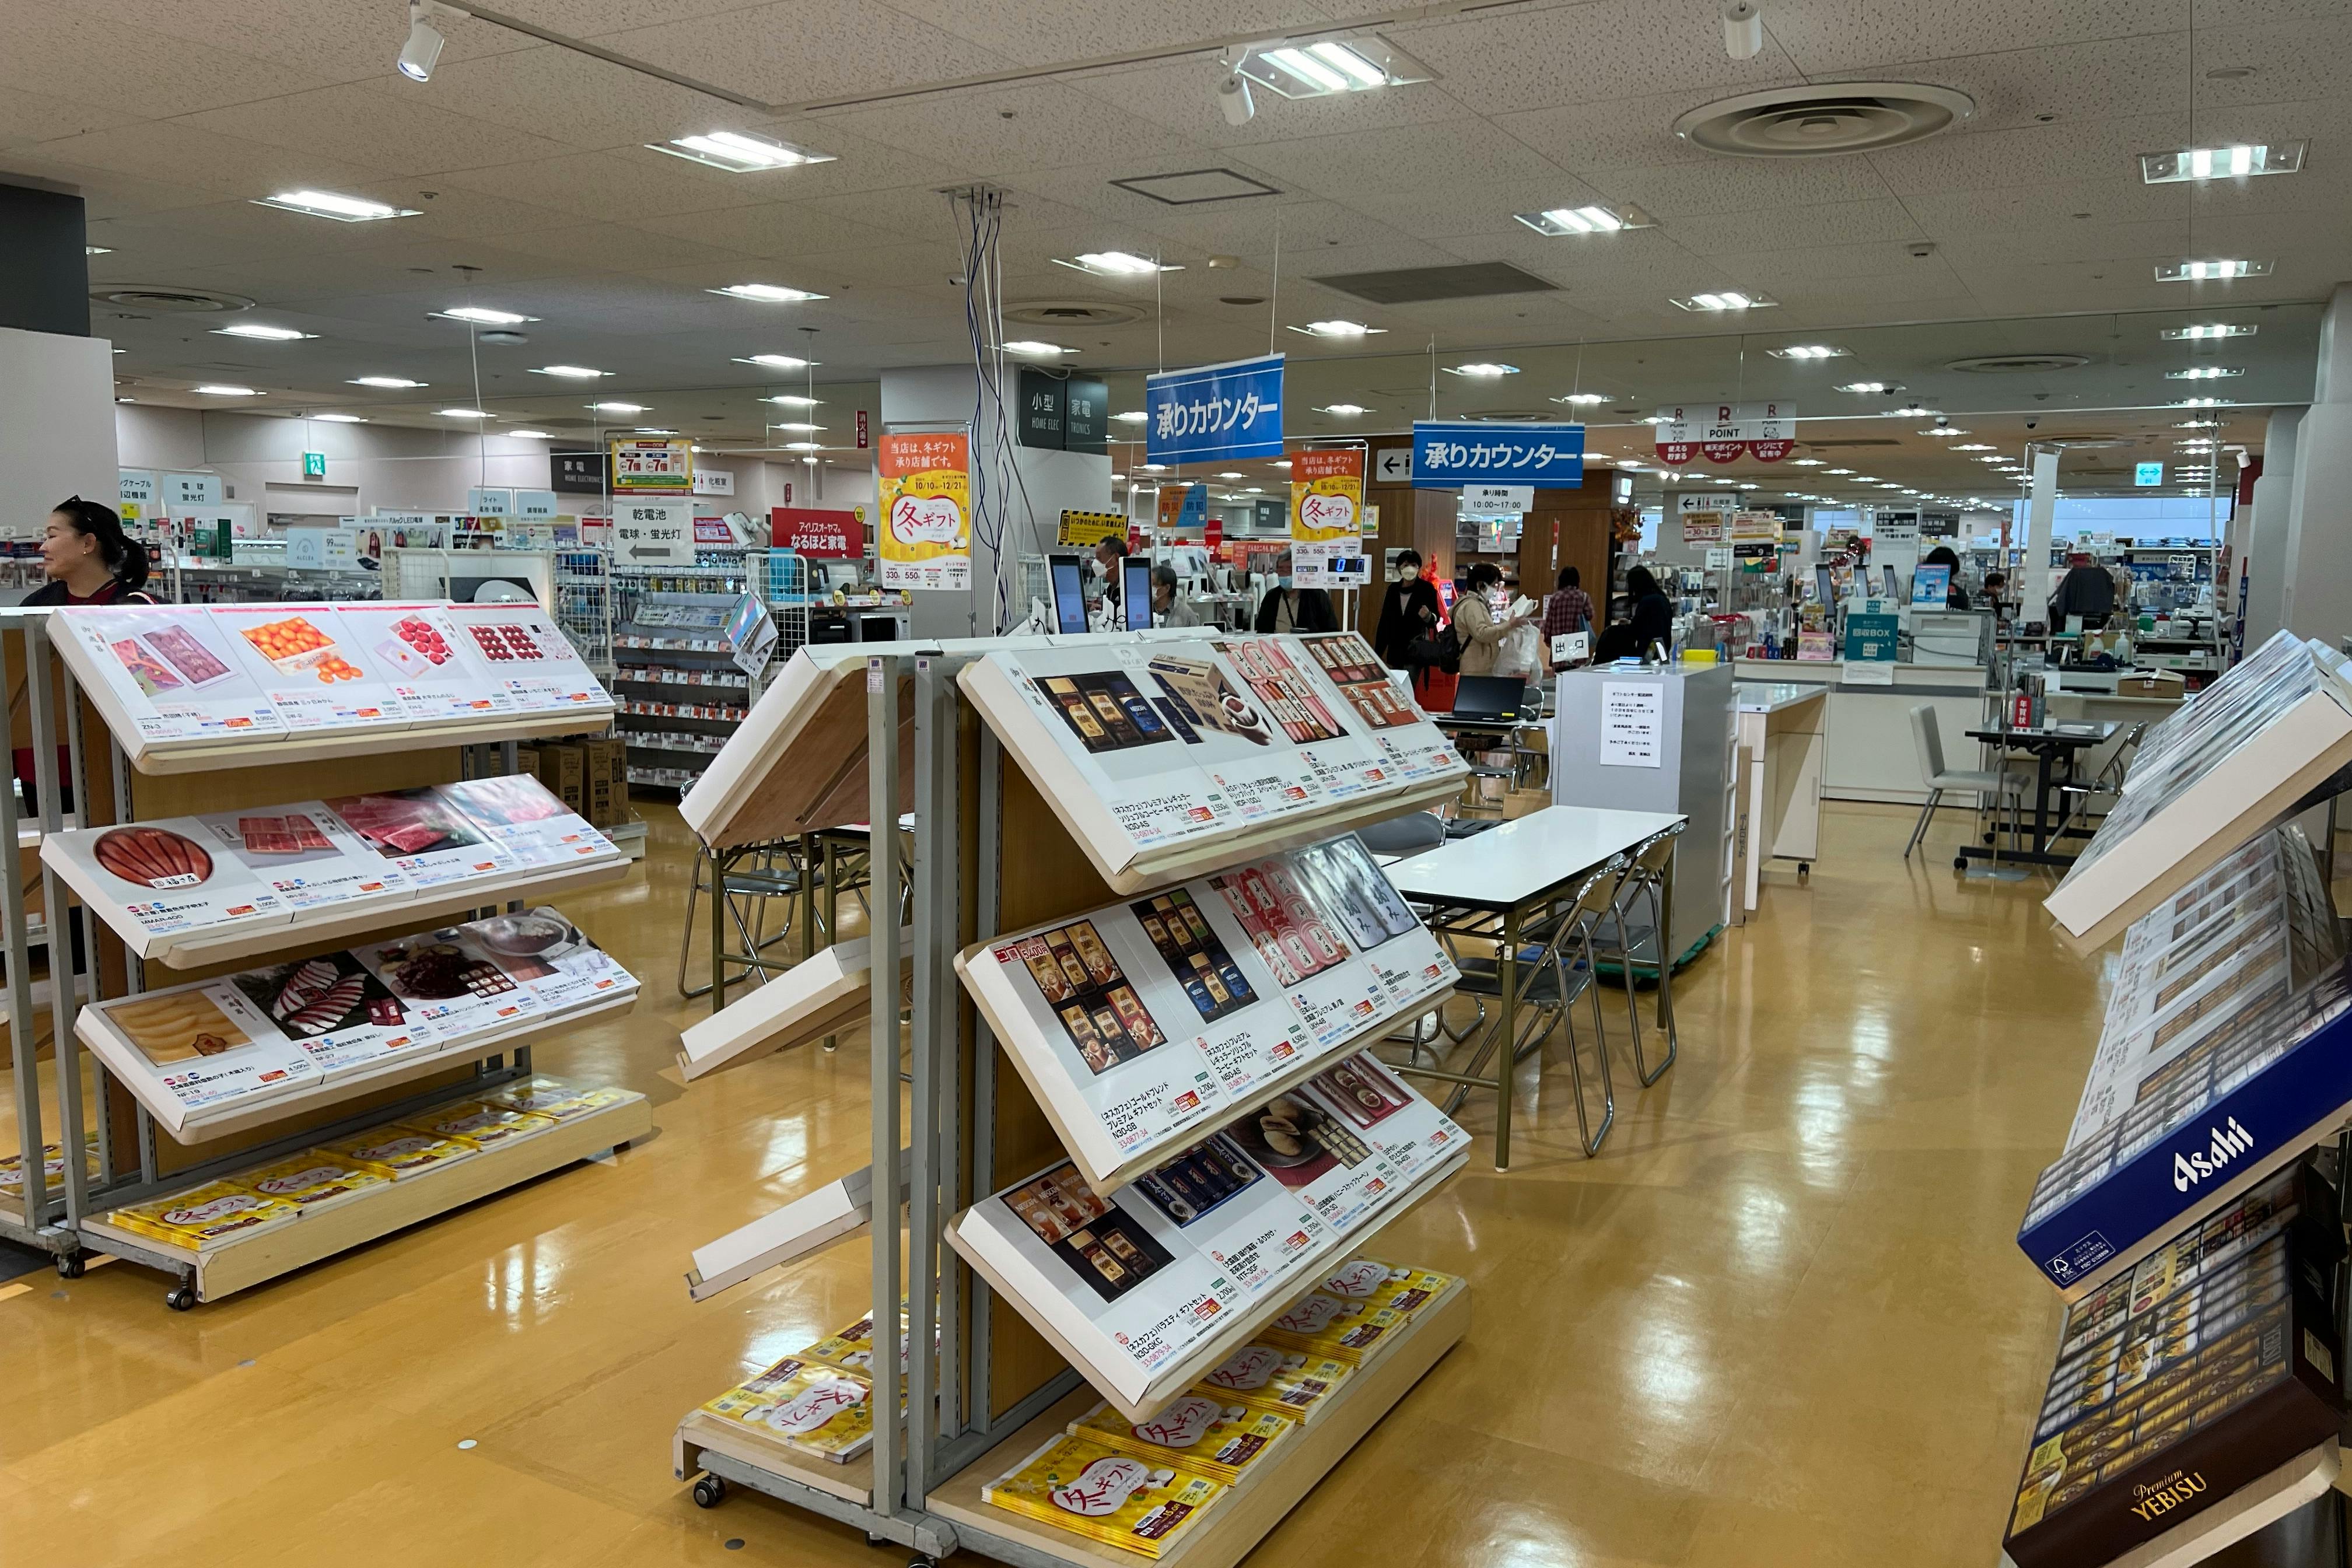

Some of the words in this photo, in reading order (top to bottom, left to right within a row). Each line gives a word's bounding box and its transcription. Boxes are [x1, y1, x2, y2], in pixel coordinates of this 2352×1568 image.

[1032, 392, 1054, 412] 小型
[1071, 399, 1091, 418] 家電
[1769, 404, 1776, 416] R
[1157, 391, 1278, 440] 承りカウンター
[1720, 406, 1731, 421] R
[1032, 417, 1046, 430] HOME
[1048, 418, 1059, 430] ELEC
[1071, 422, 1090, 435] TRONICS
[1710, 429, 1740, 438] POINT
[891, 442, 956, 454] 当店は、冬ギフト
[1705, 443, 1743, 452] 楽天ポイント
[1757, 442, 1785, 450] レジにて
[895, 456, 952, 468] 承り店舗です。
[1301, 456, 1353, 466] 当店は、冬ギフト
[1424, 442, 1577, 470] 承りカウンター
[1306, 466, 1349, 475] 承り店舗です。
[182, 494, 205, 502] 蛍光灯
[1482, 489, 1508, 498] 承り時間
[632, 508, 667, 520] 乾電池
[897, 501, 957, 538] 冬ギフト
[1305, 498, 1350, 524] 冬ギフト
[618, 528, 681, 540] 電球・蛍光灯
[791, 534, 846, 551] なるほど家電
[1853, 628, 1890, 638] 回収BOX
[2018, 699, 2028, 724] 年賀状
[1124, 820, 1150, 832] N30-AS
[1021, 946, 1049, 960] 5,400円
[1205, 1031, 1251, 1058] (ネスカフェ)プレミアム
[1220, 1067, 1242, 1082] N50-AS
[1100, 1081, 1170, 1121] (ネスカフェ)ゴールドブレンド
[1112, 1121, 1138, 1140] N30-GB
[1117, 1128, 1149, 1149] 33-0877-34
[2172, 1116, 2254, 1192] Asahi
[174, 1196, 246, 1221] 冬ギフト
[1236, 1263, 1259, 1282] NTF-30F
[1328, 1264, 1378, 1294] 冬ギフト
[1126, 1312, 1181, 1352] (ネスカフェ)バラエティ
[1178, 1292, 1208, 1314] ギフトセット
[1278, 1298, 1330, 1330] 冬ギフト
[1133, 1336, 1164, 1360] N30-GKC
[1141, 1343, 1172, 1367] 33-0879-34
[1213, 1350, 1270, 1387] 冬ギフト
[1144, 1402, 1208, 1444] 冬ギフト
[1062, 1464, 1134, 1511] 冬ギフト
[2133, 1468, 2183, 1503] Premium
[2130, 1472, 2207, 1522] YEBISU
